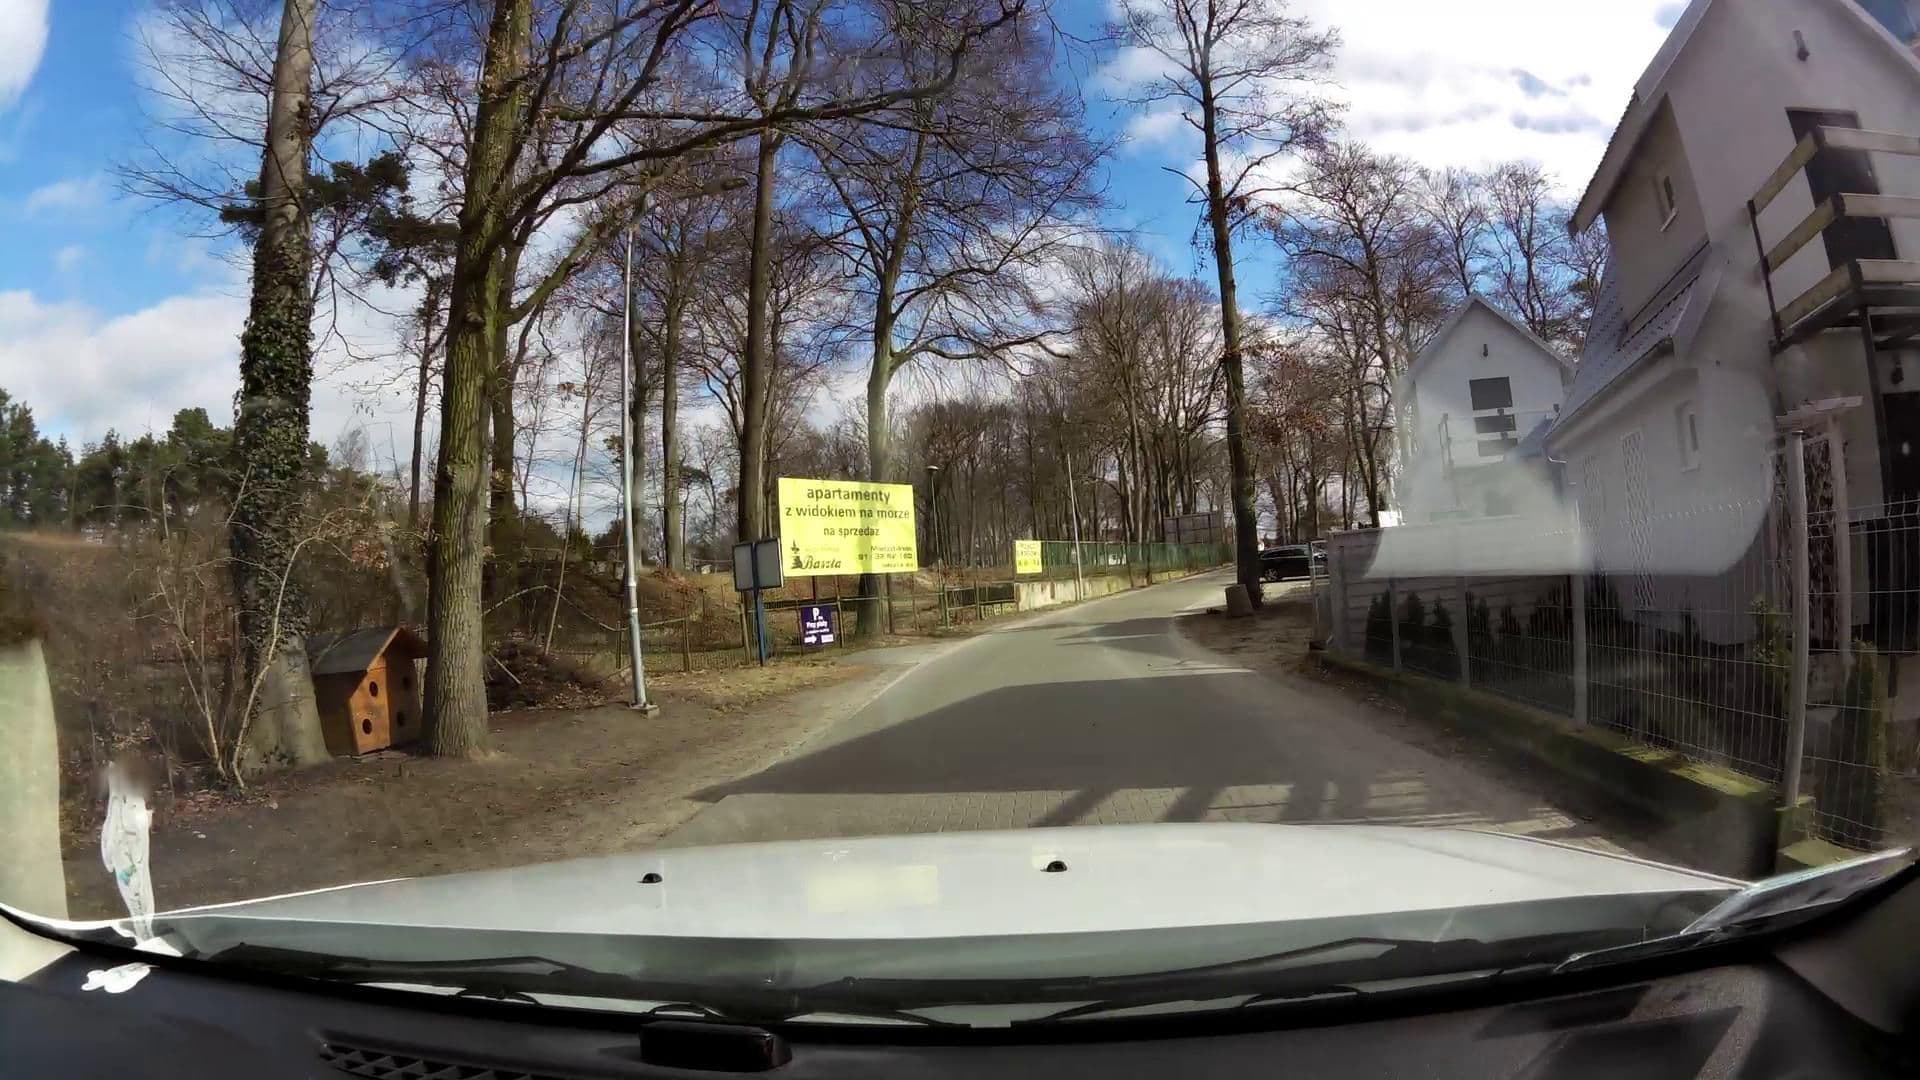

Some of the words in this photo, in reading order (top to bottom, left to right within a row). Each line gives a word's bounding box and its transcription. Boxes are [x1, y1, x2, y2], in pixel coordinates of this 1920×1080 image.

[807, 488, 890, 505] apartamenty
[785, 506, 793, 517] z
[796, 504, 856, 518] widokiem
[859, 508, 873, 518] na
[877, 508, 910, 519] morze
[823, 526, 835, 536] na
